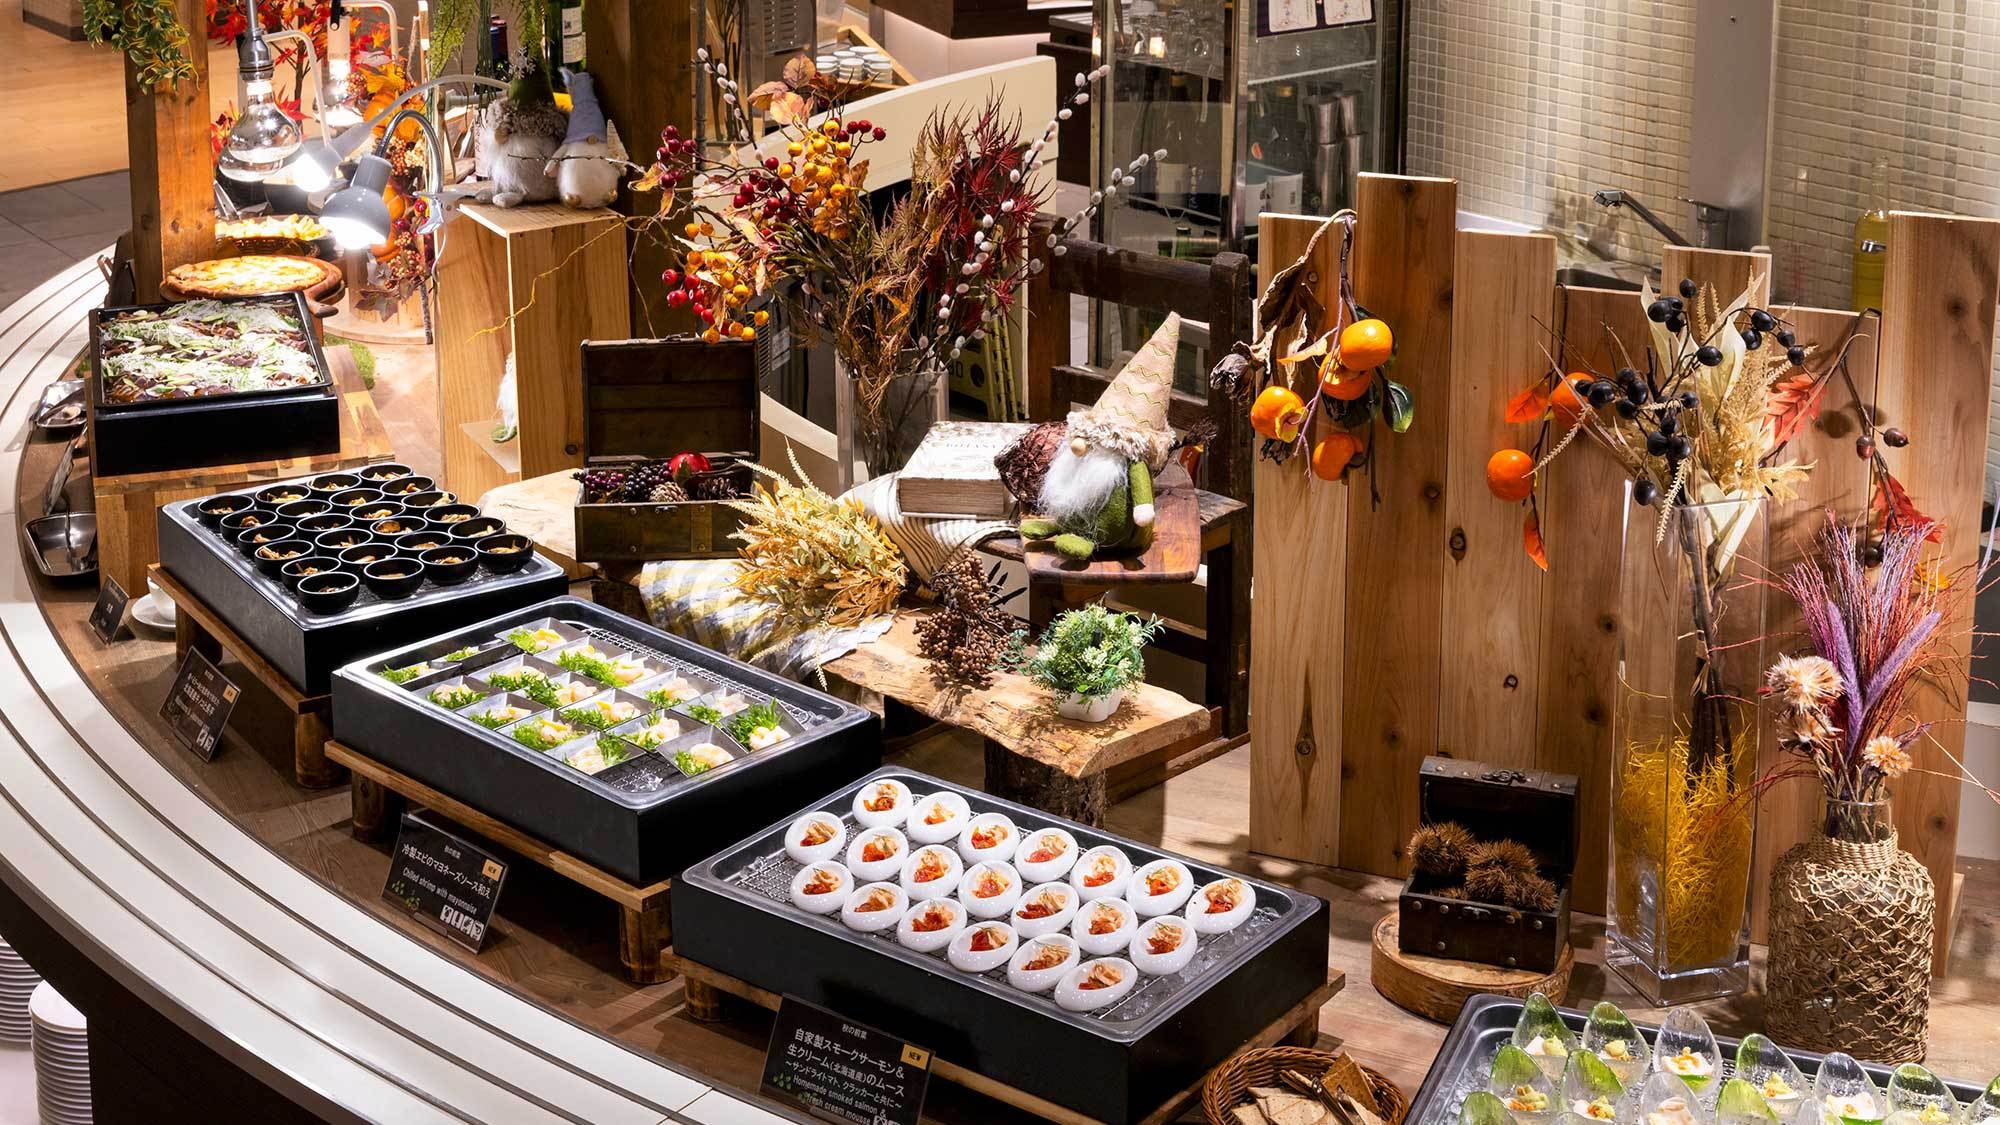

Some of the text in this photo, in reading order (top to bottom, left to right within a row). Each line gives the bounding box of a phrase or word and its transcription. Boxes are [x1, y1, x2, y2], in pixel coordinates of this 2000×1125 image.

[401, 843, 491, 899] 冷製エビのマヨネーズソース和え
[403, 867, 419, 883] Chilled
[419, 877, 436, 893] shrimp
[436, 886, 448, 898] with
[842, 1024, 867, 1040] 秋の前菜
[909, 1051, 921, 1062] NEW
[793, 1075, 887, 1118] Homemade smoked salmon &
[824, 1102, 844, 1115] cream
[845, 1110, 871, 1125] mousse
